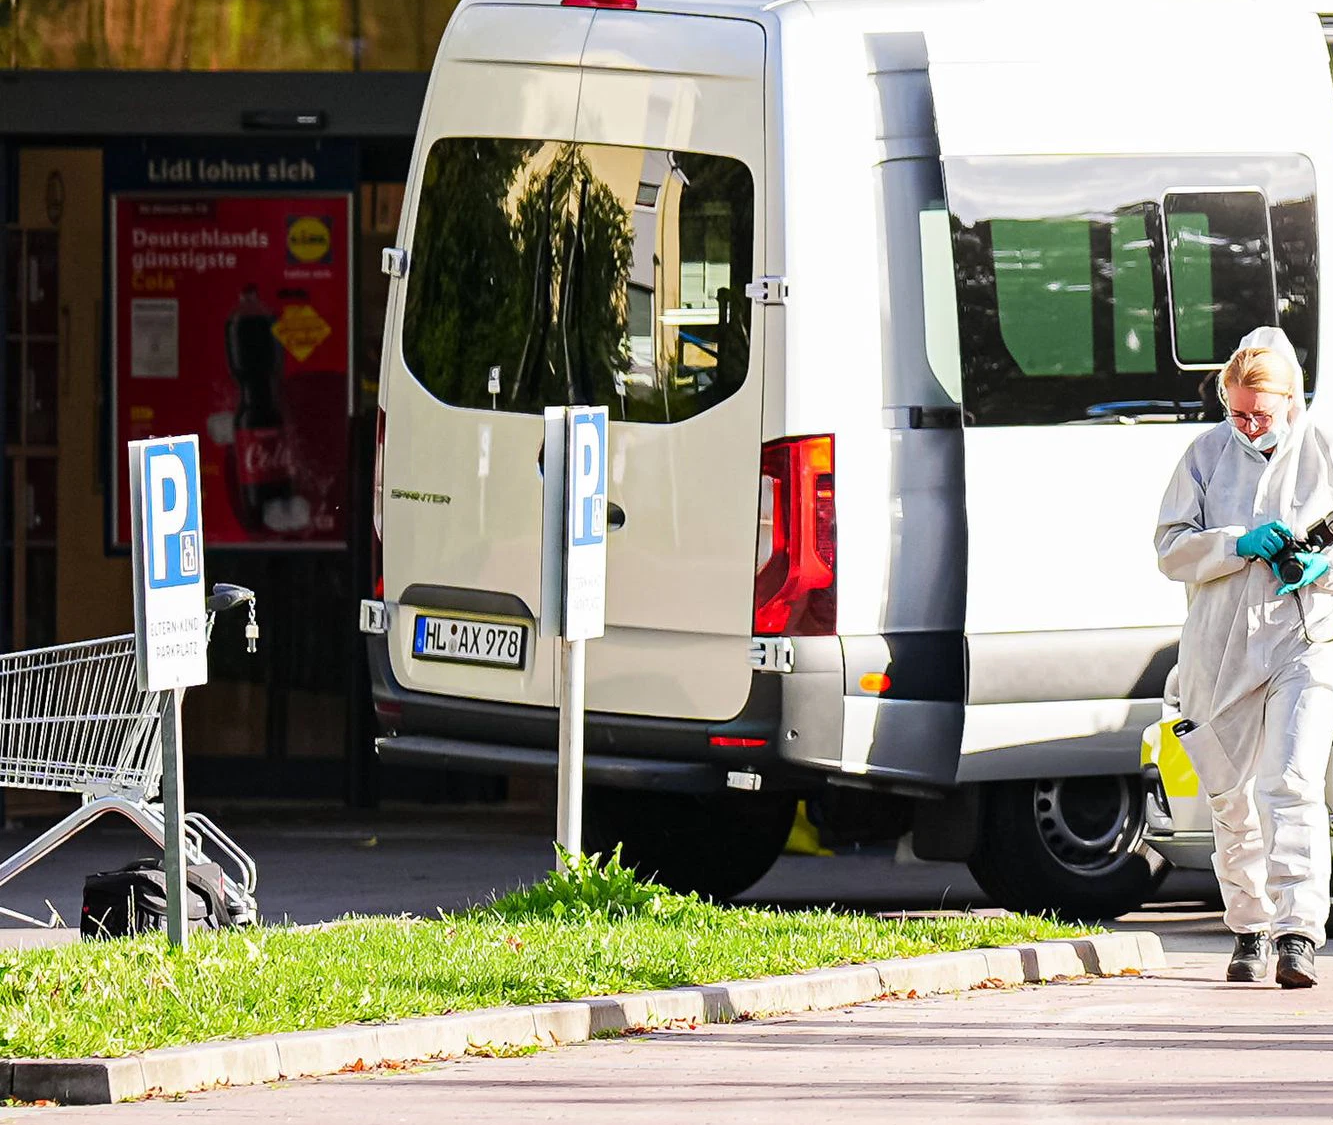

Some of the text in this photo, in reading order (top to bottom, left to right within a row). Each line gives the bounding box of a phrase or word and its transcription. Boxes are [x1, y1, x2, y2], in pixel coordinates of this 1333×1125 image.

[148, 159, 315, 181] Lidl lohnt sich
[132, 228, 270, 248] Deutschlands
[132, 251, 237, 273] günstigste
[574, 422, 600, 539] P
[150, 453, 188, 581] P
[150, 617, 199, 637] ELTERN-KIND
[155, 641, 198, 660] PARKPLATZ
[425, 622, 519, 659] HL AX 978
